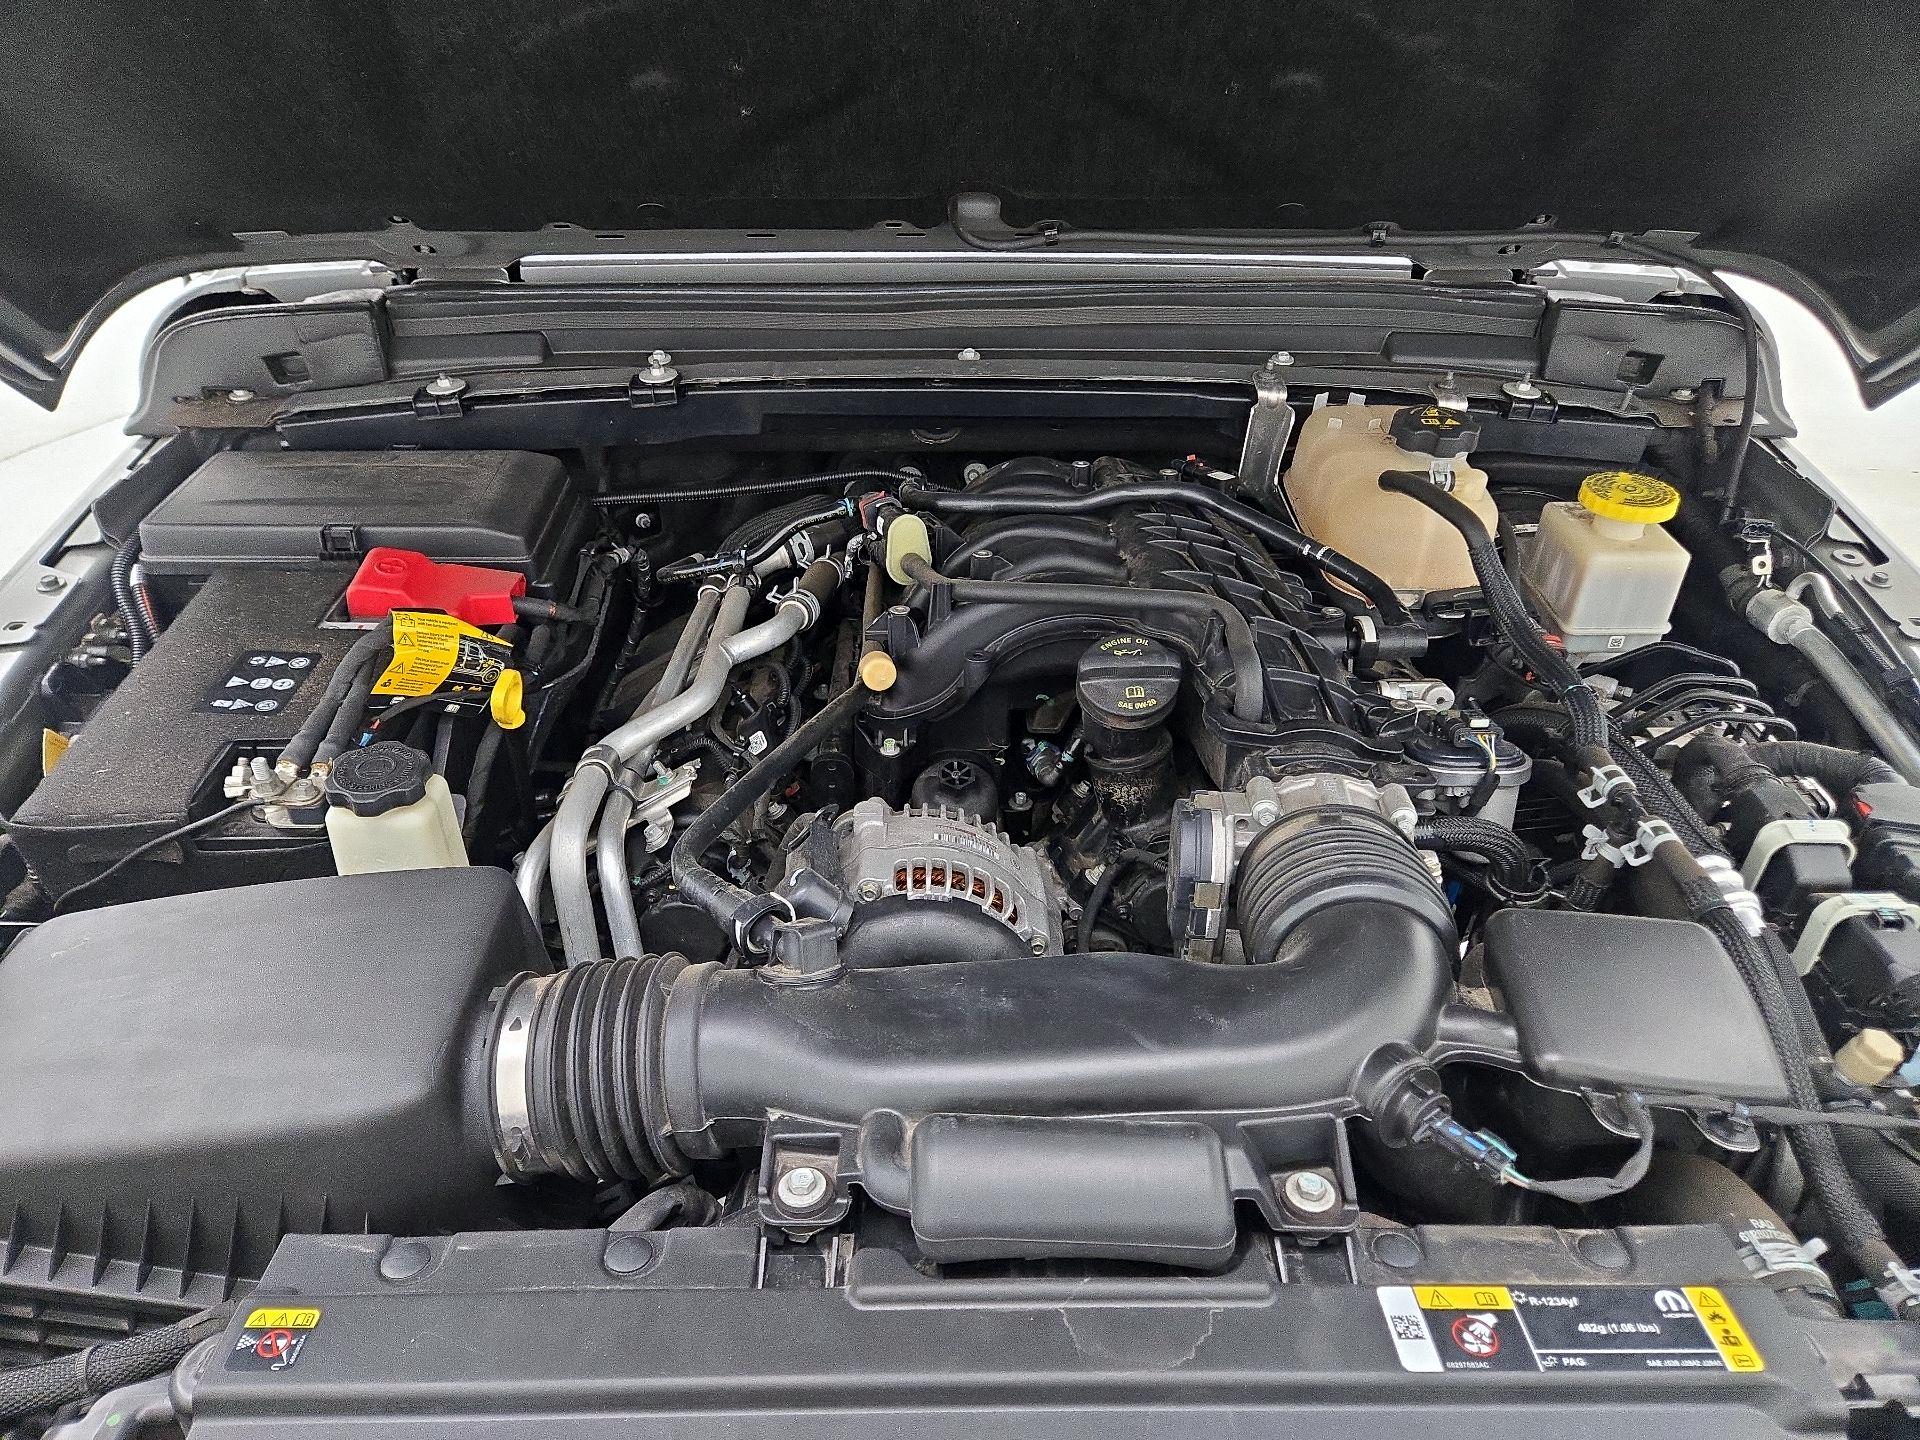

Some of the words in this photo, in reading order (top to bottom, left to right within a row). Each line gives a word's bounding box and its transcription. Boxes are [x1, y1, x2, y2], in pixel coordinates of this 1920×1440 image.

[1100, 637, 1132, 651] ENGINE
[1135, 638, 1149, 646] OIL
[1117, 701, 1134, 709] SAE
[1528, 1296, 1579, 1308] R-1234yf
[1636, 1323, 1661, 1335] lbs)
[1562, 1357, 1587, 1367] PAG
